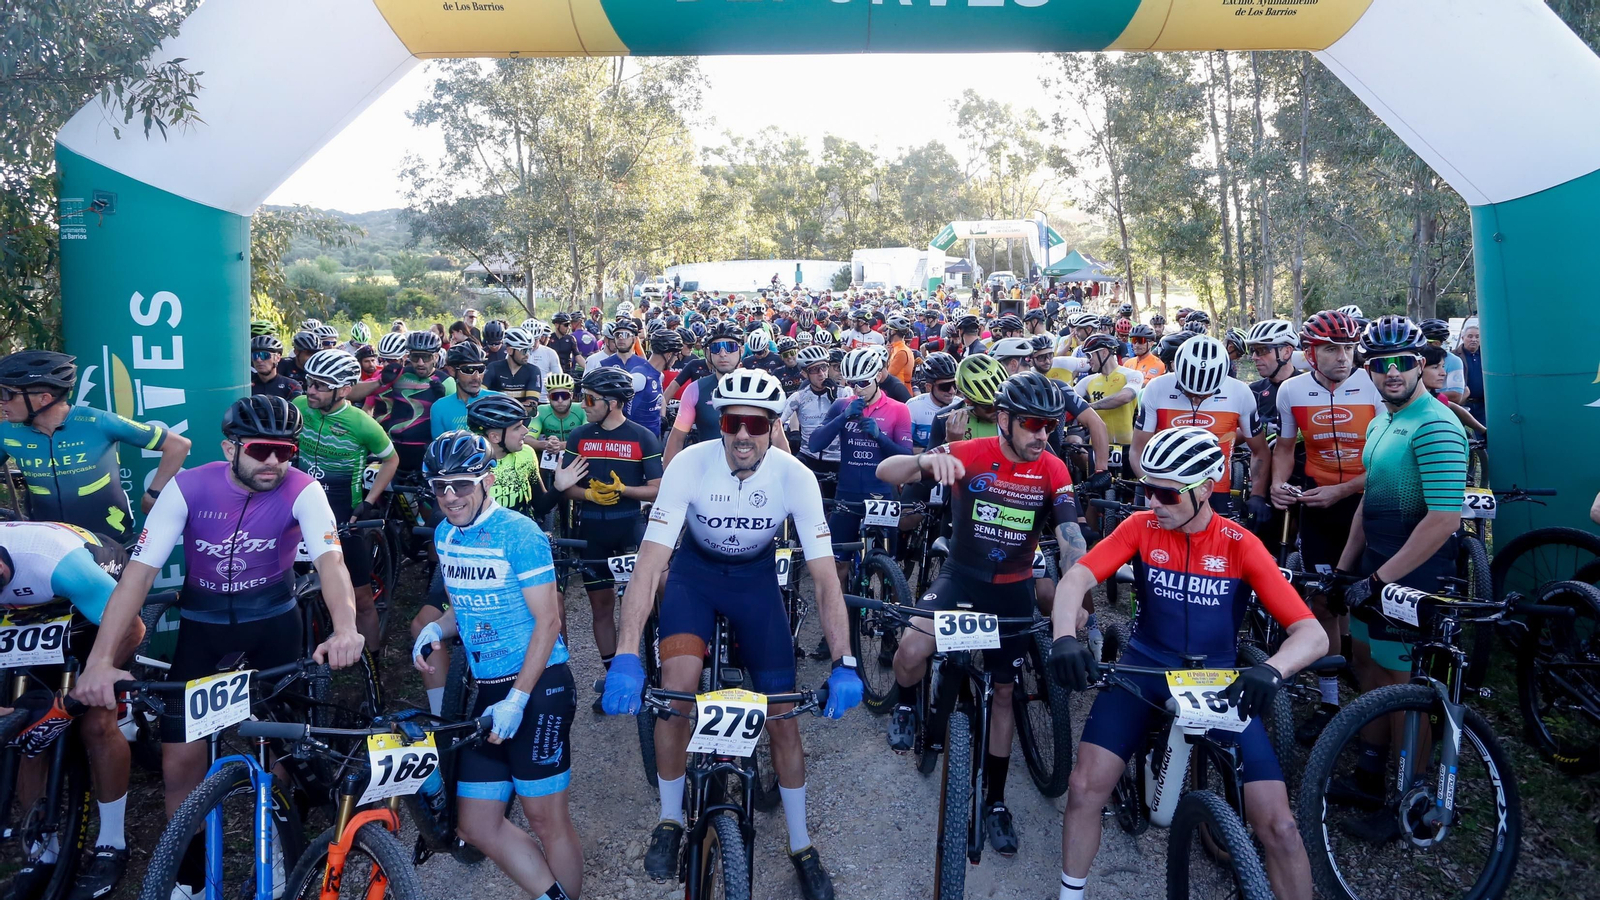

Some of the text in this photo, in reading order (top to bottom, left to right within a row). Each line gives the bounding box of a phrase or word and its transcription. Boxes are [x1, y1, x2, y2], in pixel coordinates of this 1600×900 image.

[443, 2, 504, 11] de Los Barrios
[584, 442, 632, 454] CONIL RACING
[868, 501, 900, 517] 273
[1463, 495, 1495, 510] 23
[696, 514, 776, 530] COTREL
[974, 524, 1027, 541] SENA E HIJOS
[447, 565, 496, 579] MANILVA
[199, 577, 267, 592] 512 BIKES
[1148, 568, 1230, 595] FALI BIKE
[939, 614, 997, 636] 366
[0, 625, 64, 653] 309
[190, 674, 248, 720] 062
[699, 705, 765, 739] 279
[378, 753, 437, 786] 166
